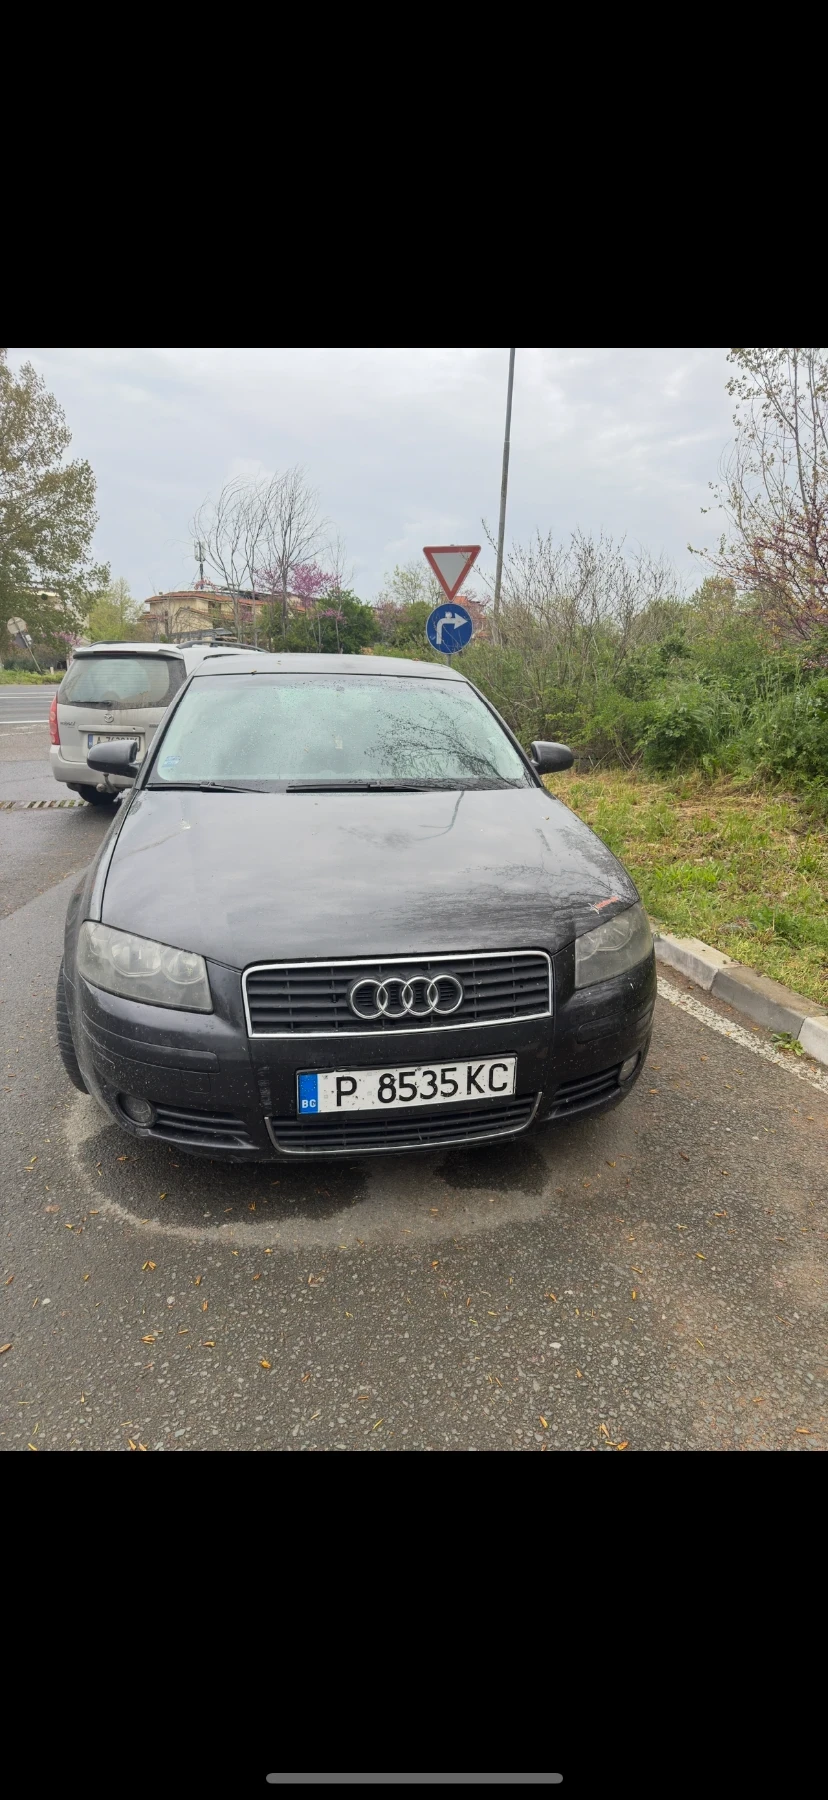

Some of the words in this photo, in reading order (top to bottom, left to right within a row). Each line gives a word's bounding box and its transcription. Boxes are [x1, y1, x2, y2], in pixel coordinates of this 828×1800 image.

[335, 1076, 357, 1107] P
[377, 1067, 459, 1104] 8535
[466, 1063, 509, 1096] KC
[301, 1099, 317, 1109] BG
